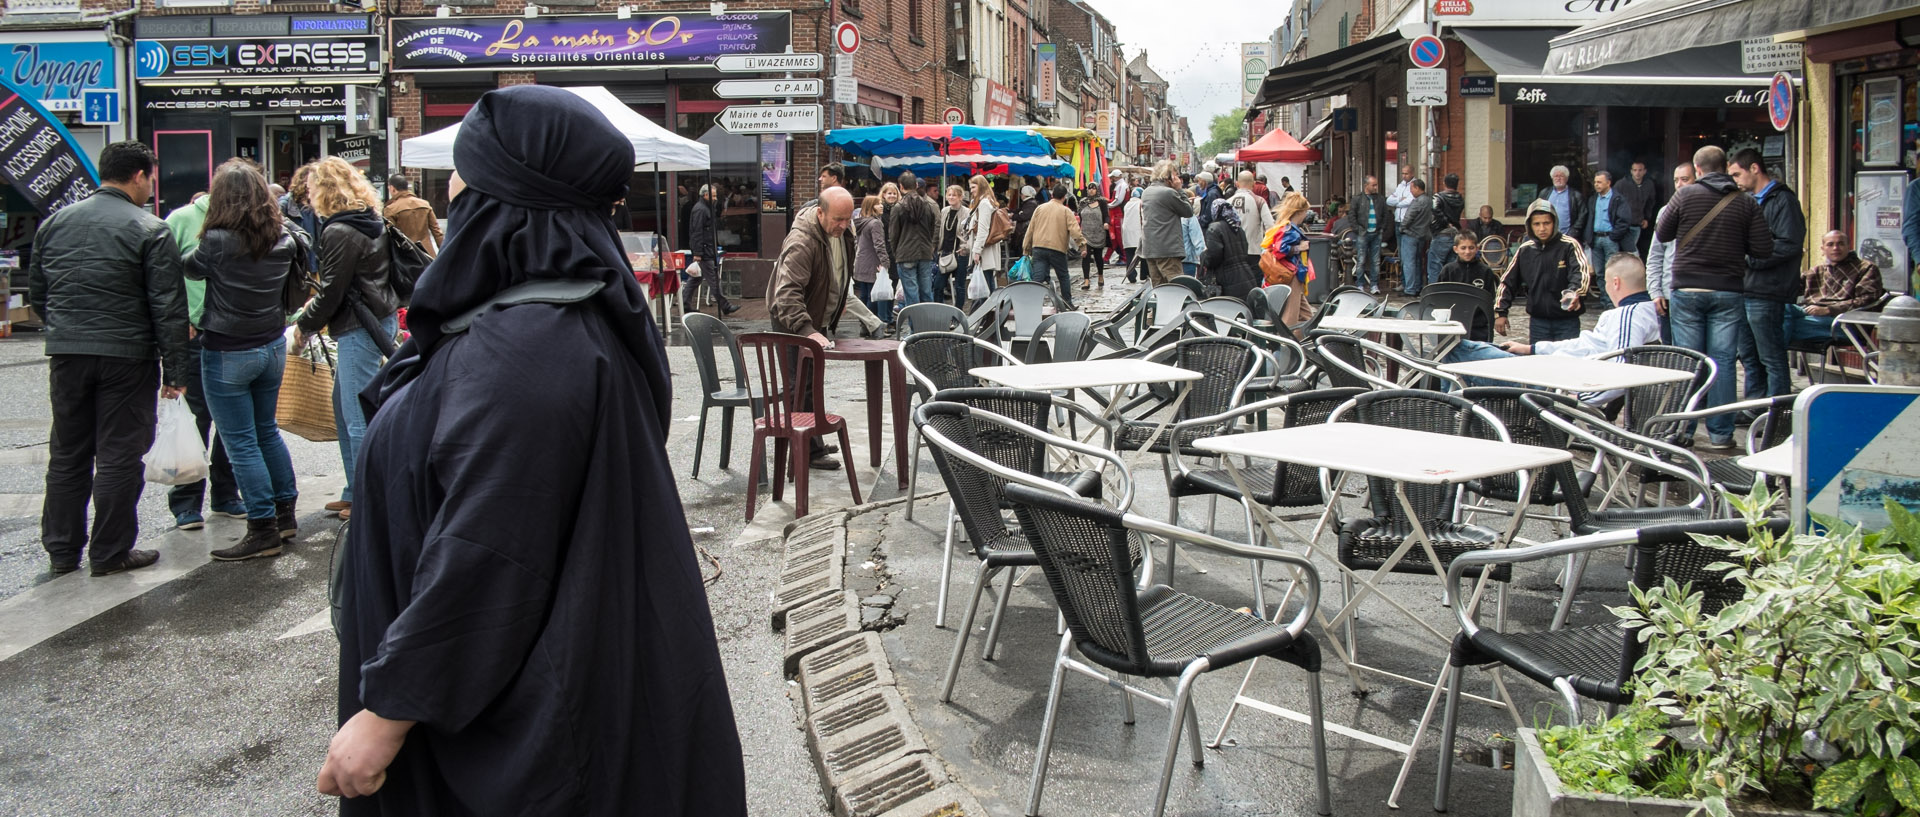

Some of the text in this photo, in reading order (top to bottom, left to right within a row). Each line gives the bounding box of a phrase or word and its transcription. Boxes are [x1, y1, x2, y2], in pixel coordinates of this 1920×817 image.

[716, 13, 758, 21] COUSCOUS
[216, 20, 287, 32] REPARATION
[293, 19, 367, 31] INFORMATIQUE
[396, 27, 483, 48] CHANGEMENT
[430, 37, 445, 45] DE
[485, 16, 694, 57] La main d'Or
[716, 33, 758, 41] GRILLADES
[1744, 37, 1771, 45] MARDIS
[719, 43, 757, 51] TRAITEUR
[1576, 39, 1616, 67] RELAX
[172, 42, 367, 66] GSM EXPRESS
[405, 46, 468, 64] PROPRIETAIRE
[512, 50, 666, 64] Spécialités Orientales
[1763, 51, 1800, 60] DIMANCHE
[757, 58, 815, 67] WAZEMMES
[12, 44, 103, 100] Voyage
[171, 86, 334, 96] VENTE RÉPARATION
[774, 84, 815, 92] C.P.A.M.
[1469, 86, 1494, 94] SARRAZINS
[1515, 87, 1547, 103] Leffe
[1724, 89, 1753, 104] Au
[146, 100, 251, 109] ACCESSOIRES
[729, 109, 814, 119] Mairie de Quartier
[0, 106, 38, 152] LEPHONIE
[730, 121, 779, 129] Wazemmes
[344, 139, 366, 148] TOUT
[3, 126, 62, 180] ACCESSOIRES
[337, 147, 365, 159] VOTRE
[28, 152, 77, 199] REPARATION
